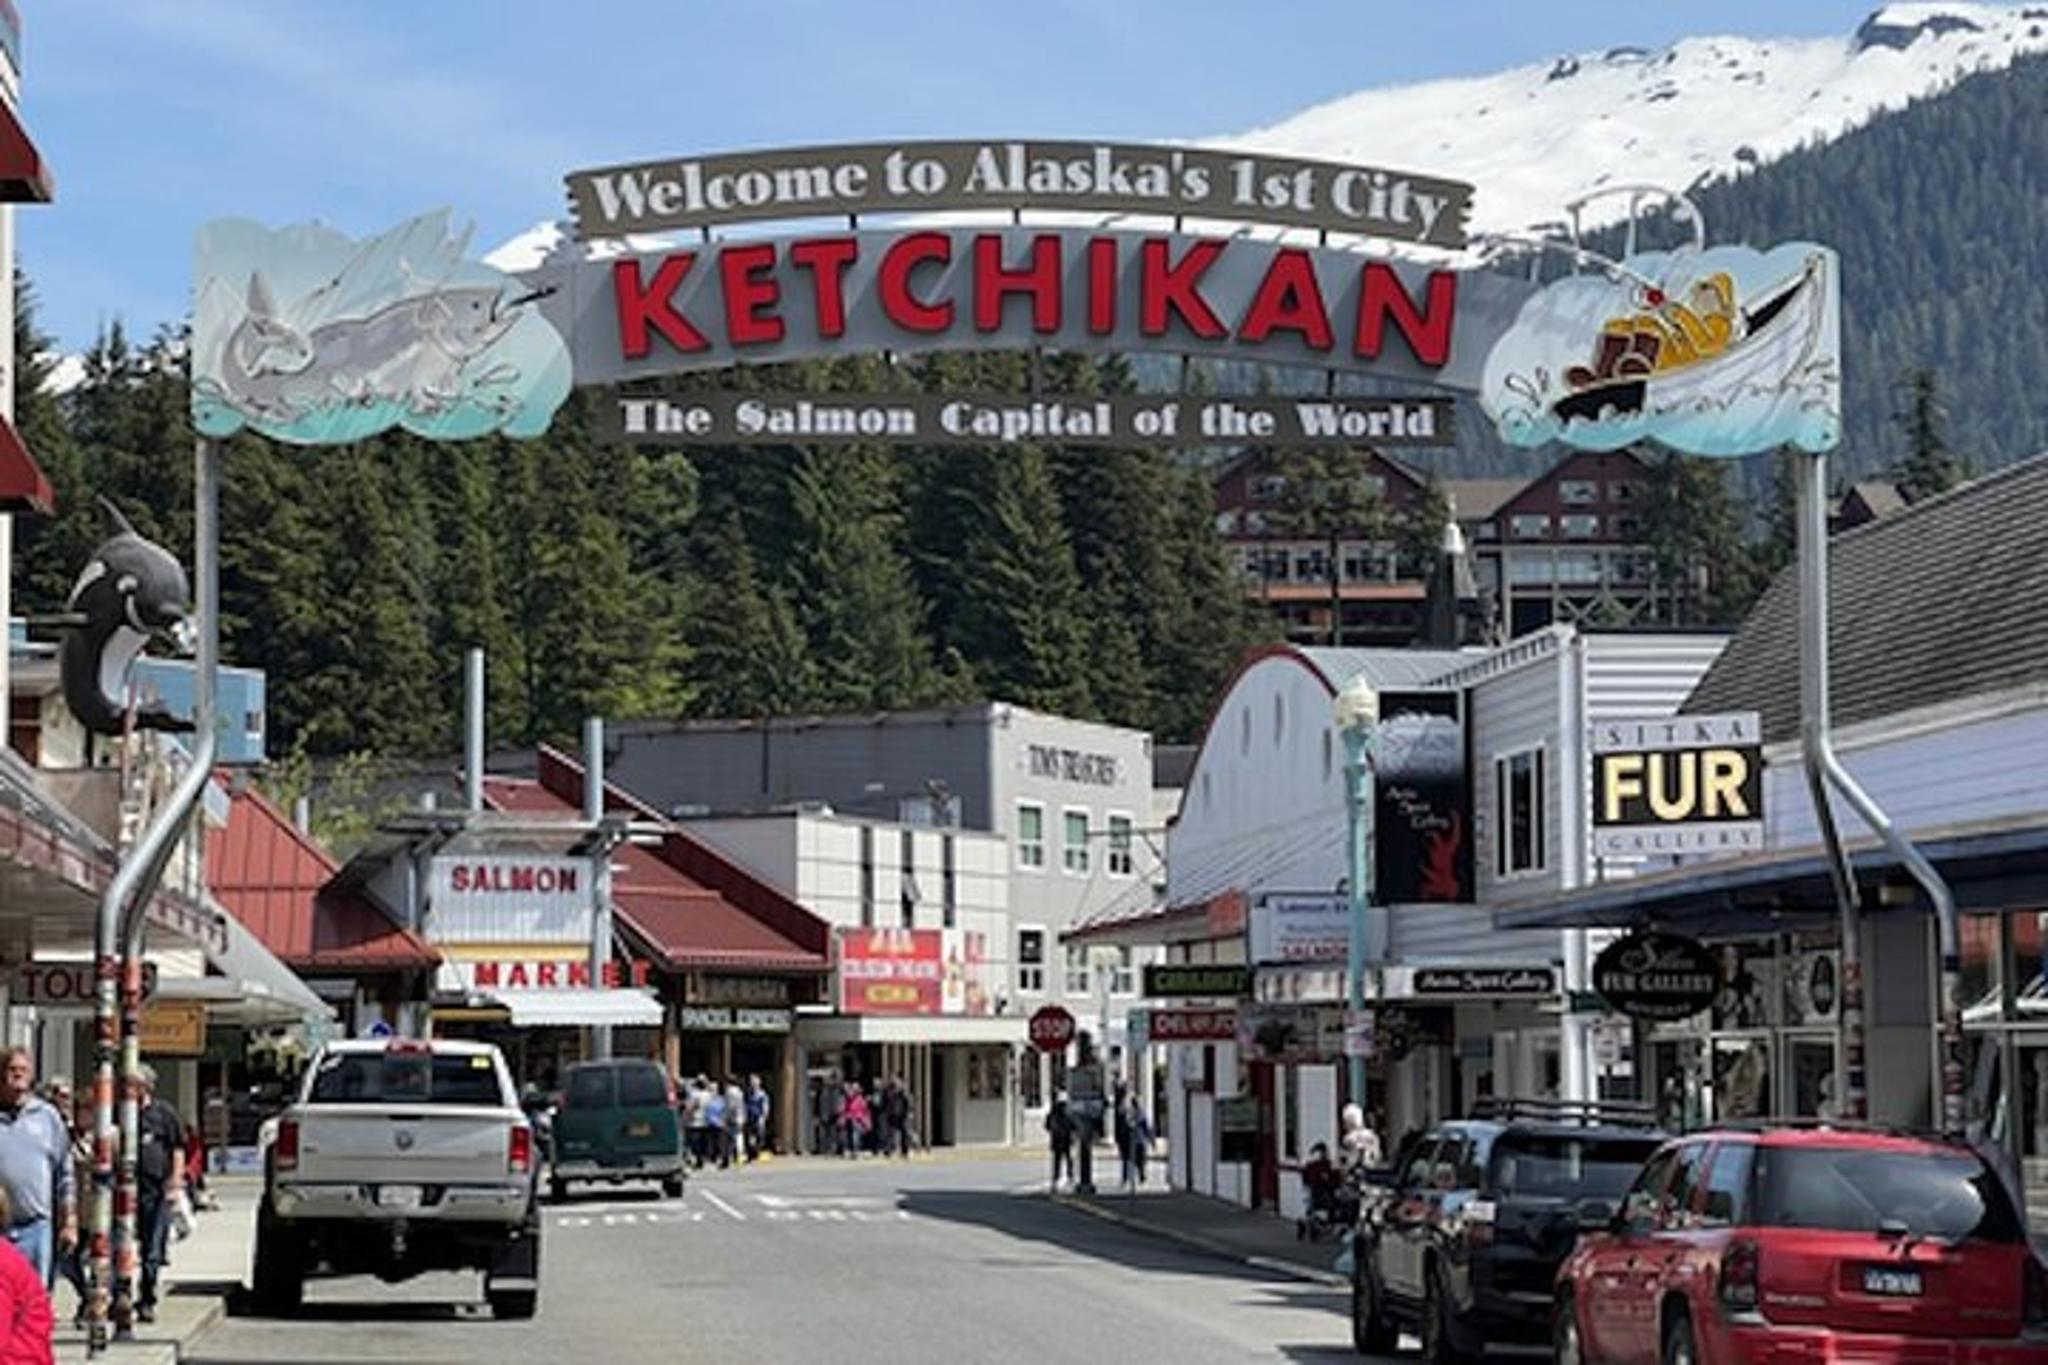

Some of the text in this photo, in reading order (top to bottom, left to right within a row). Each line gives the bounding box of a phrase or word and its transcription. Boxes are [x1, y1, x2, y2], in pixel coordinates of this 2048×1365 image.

[592, 144, 1448, 239] Welcome to Alaska's 1st City
[612, 231, 1457, 367] KETCHIKAN
[619, 400, 1435, 441] The Salmon Capital of the World
[1607, 718, 1745, 746] SITKA
[1603, 749, 1749, 822] FUR
[1607, 830, 1753, 850] GALLERY
[451, 865, 577, 892] SALMON
[22, 968, 151, 998] TOU
[474, 961, 652, 987] MARKET
